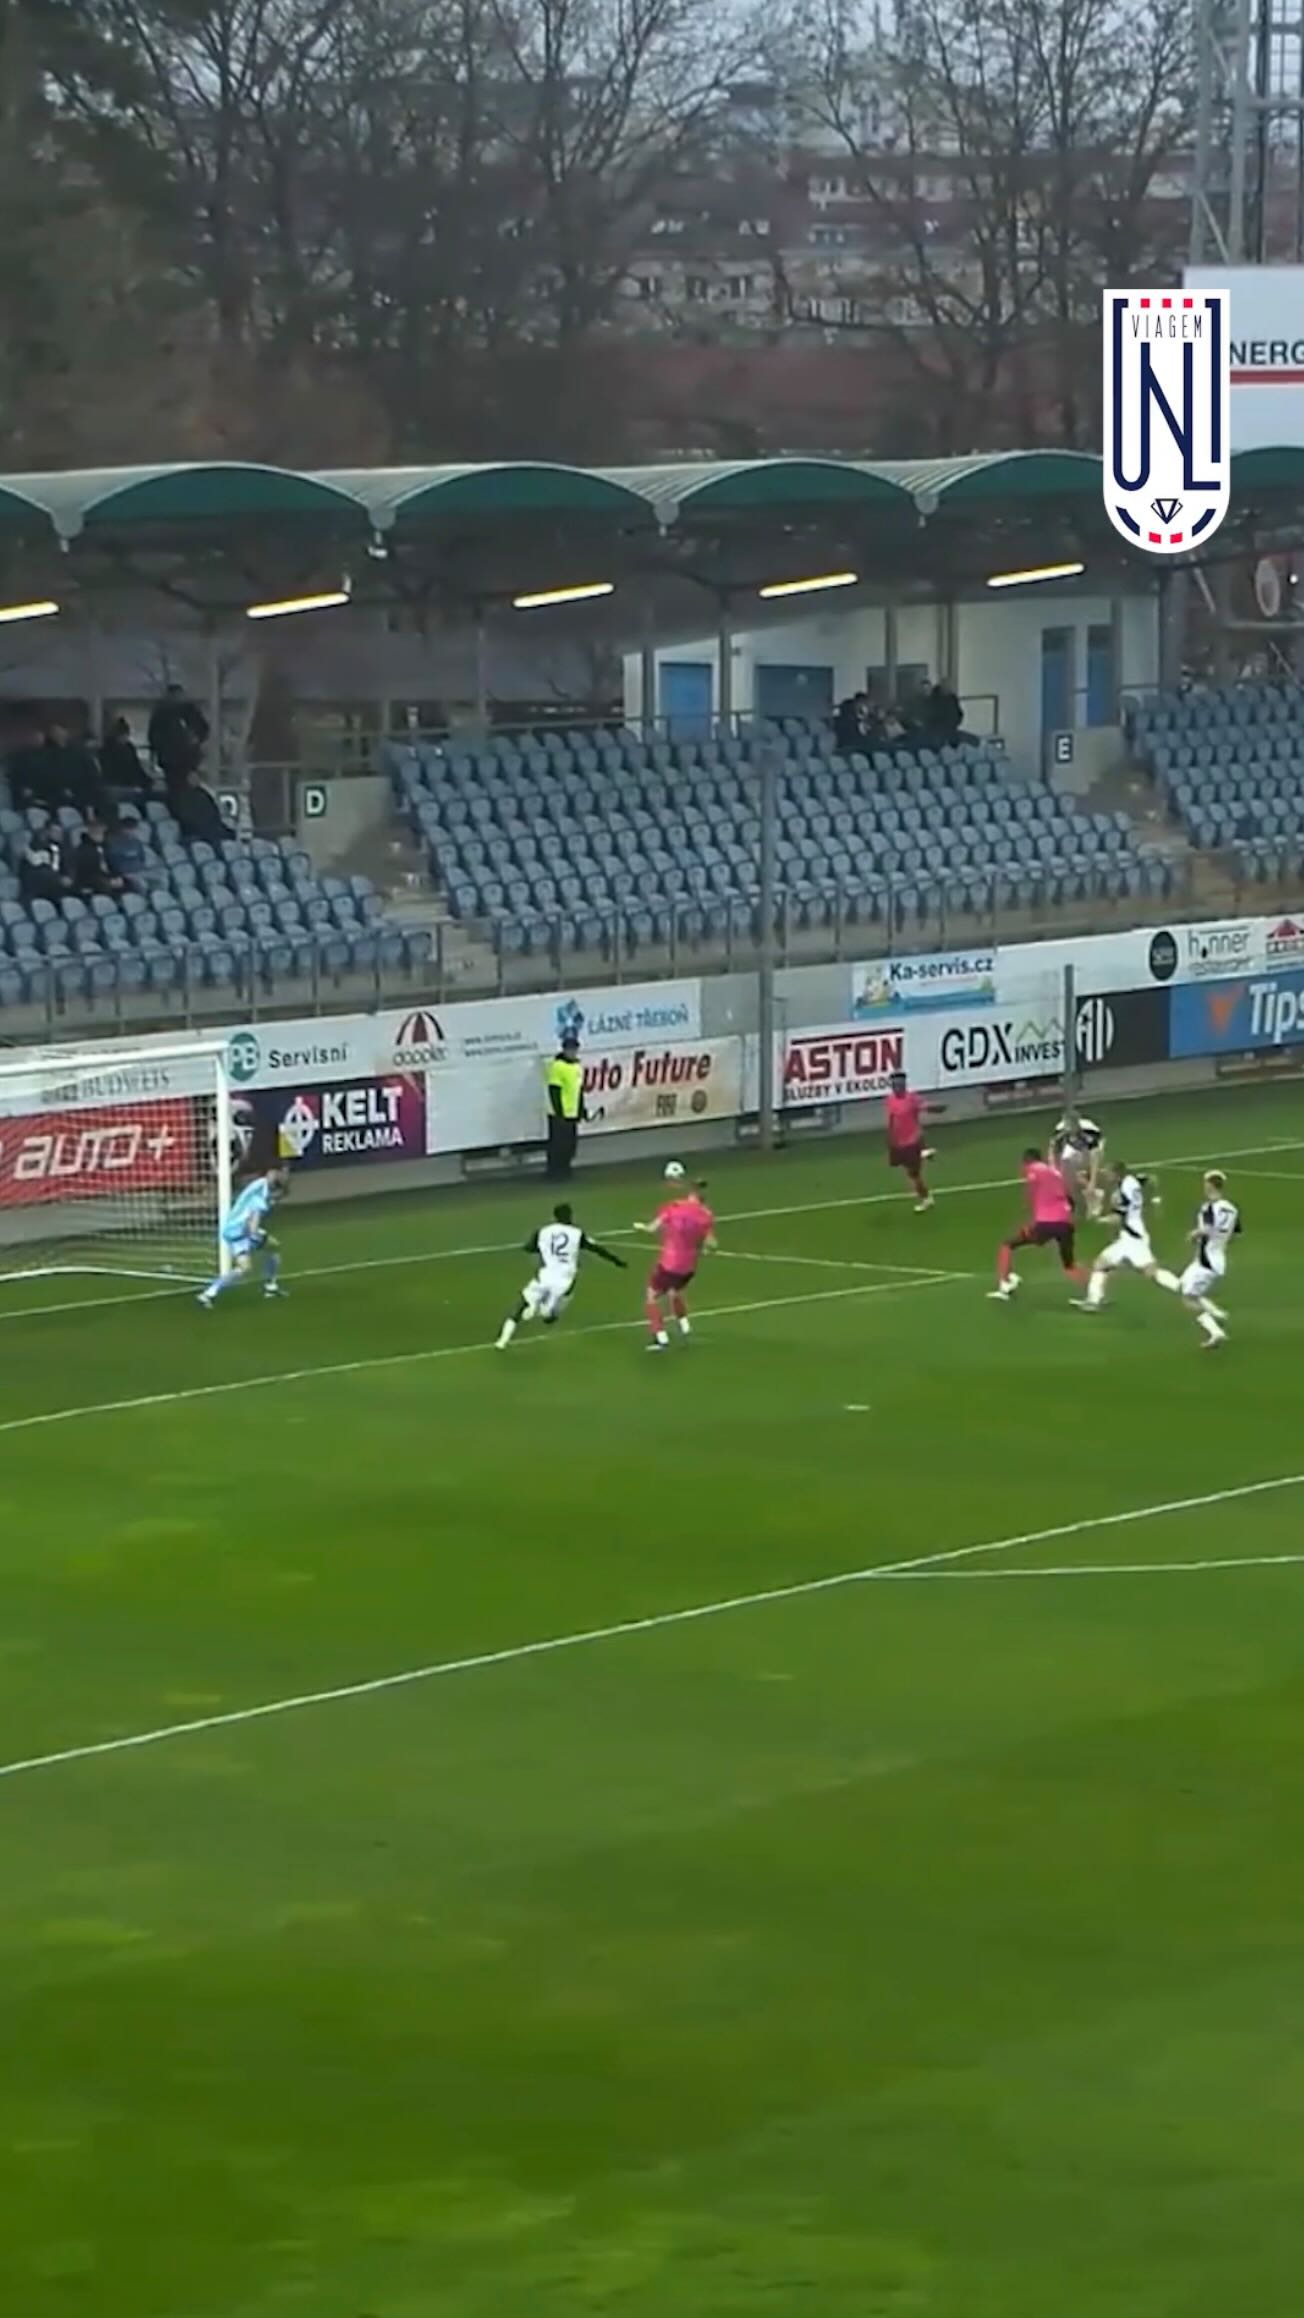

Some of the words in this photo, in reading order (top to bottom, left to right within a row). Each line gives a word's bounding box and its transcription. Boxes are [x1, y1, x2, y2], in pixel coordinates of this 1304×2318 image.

[1058, 737, 1071, 760] E
[306, 790, 325, 814] D
[889, 956, 994, 981] Ka-servis.cz
[784, 1037, 903, 1082] ASTON
[941, 1021, 1013, 1071] GDX
[583, 1058, 622, 1094] uto
[632, 1049, 712, 1088] Future
[321, 1085, 404, 1129] KELT
[322, 1126, 404, 1154] REKLAMA
[550, 1231, 569, 1257] 12
